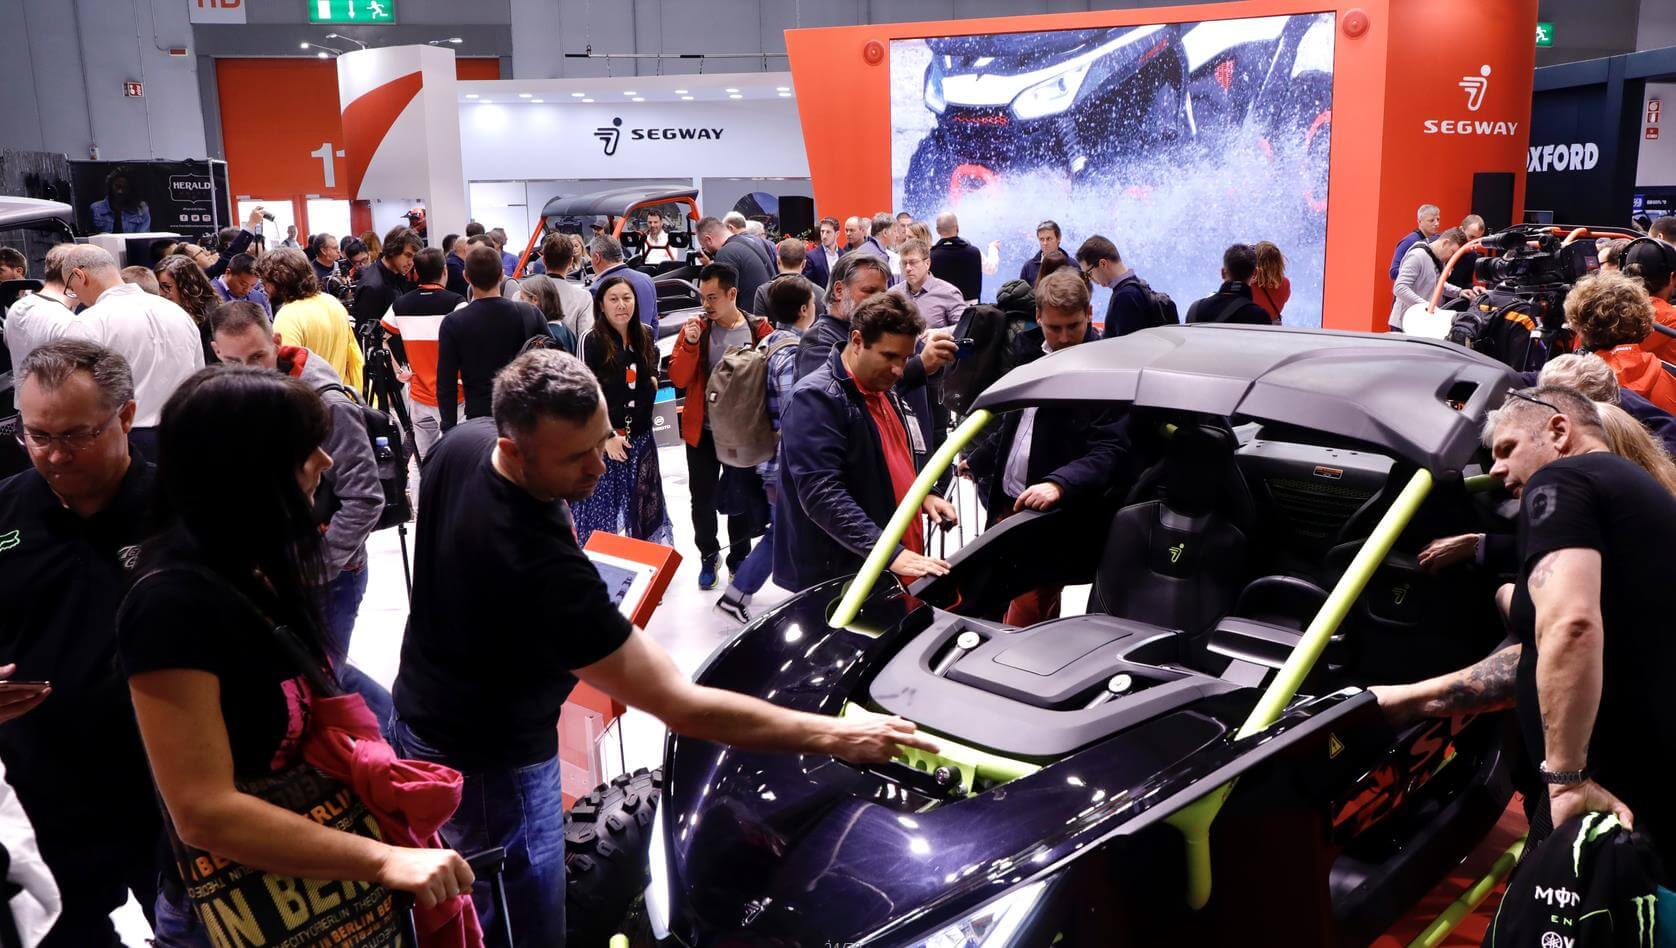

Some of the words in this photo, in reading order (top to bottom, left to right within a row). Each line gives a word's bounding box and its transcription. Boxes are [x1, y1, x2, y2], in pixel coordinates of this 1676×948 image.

[631, 128, 724, 140] SEGWAY
[1423, 119, 1518, 136] SEGWAY
[310, 142, 345, 188] 1
[1526, 142, 1599, 172] XFORD
[173, 181, 211, 190] HERALD
[331, 911, 375, 943] BERLIN
